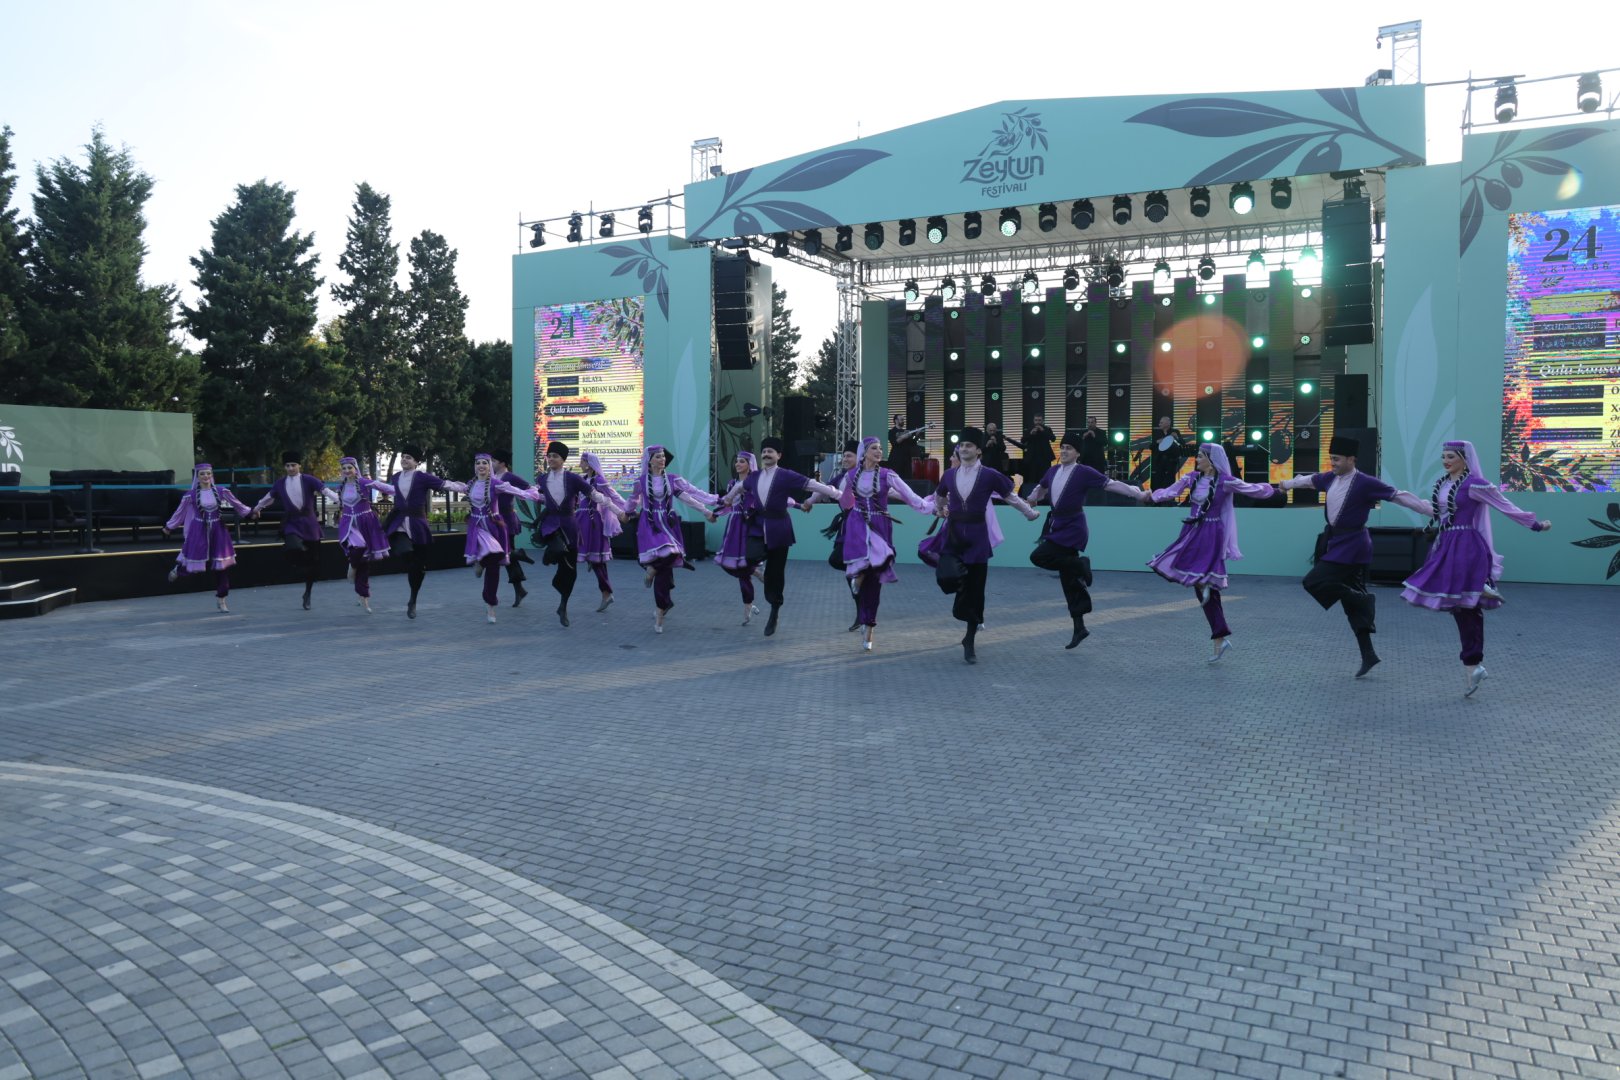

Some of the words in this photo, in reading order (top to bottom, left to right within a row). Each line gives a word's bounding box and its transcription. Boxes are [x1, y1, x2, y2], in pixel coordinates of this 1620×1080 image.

[960, 155, 1044, 184] Zeytun
[981, 182, 1027, 198] FESTİVALI
[1542, 225, 1602, 262] 24
[1538, 261, 1610, 274] OKTYABR
[1540, 364, 1573, 378] Qala
[550, 406, 566, 415] Qala
[567, 404, 590, 414] konsert
[582, 419, 601, 427] ORXAN
